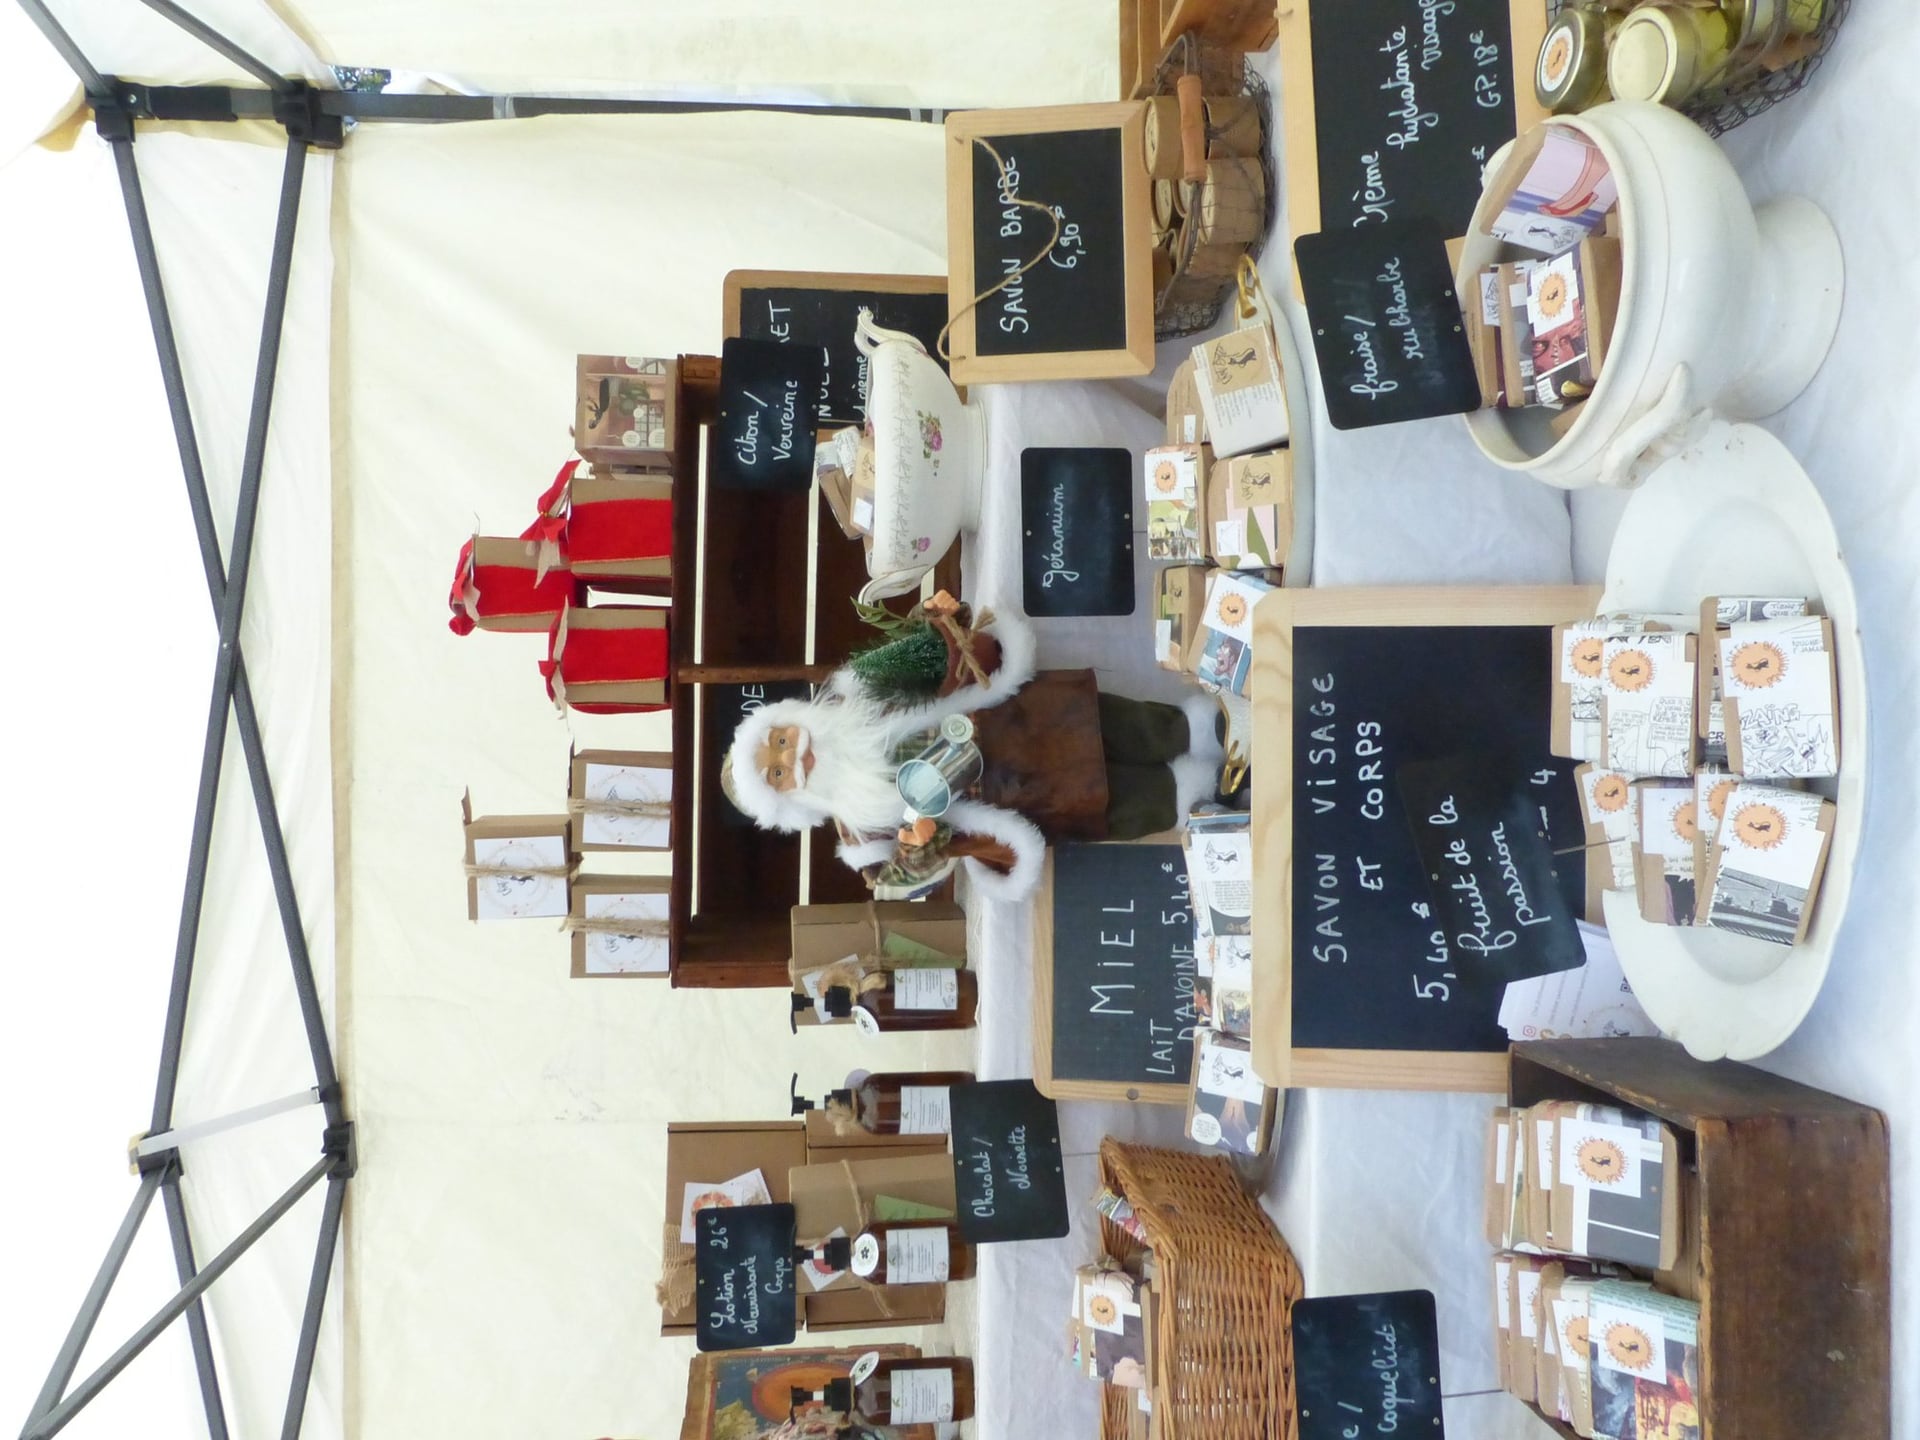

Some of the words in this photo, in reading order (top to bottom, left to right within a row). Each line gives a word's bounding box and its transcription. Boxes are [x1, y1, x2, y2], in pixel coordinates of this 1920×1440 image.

[1379, 26, 1439, 150] hydratante
[996, 156, 1023, 237] BARBE
[998, 258, 1029, 334] SAVON
[1428, 794, 1460, 826] la
[1356, 855, 1384, 891] ET
[1442, 838, 1474, 866] de
[1490, 820, 1552, 926] passion
[1311, 852, 1348, 963] SAVON
[1450, 872, 1518, 957] fruit
[1005, 1124, 1031, 1189] Noisette
[710, 1268, 736, 1328] Lotion
